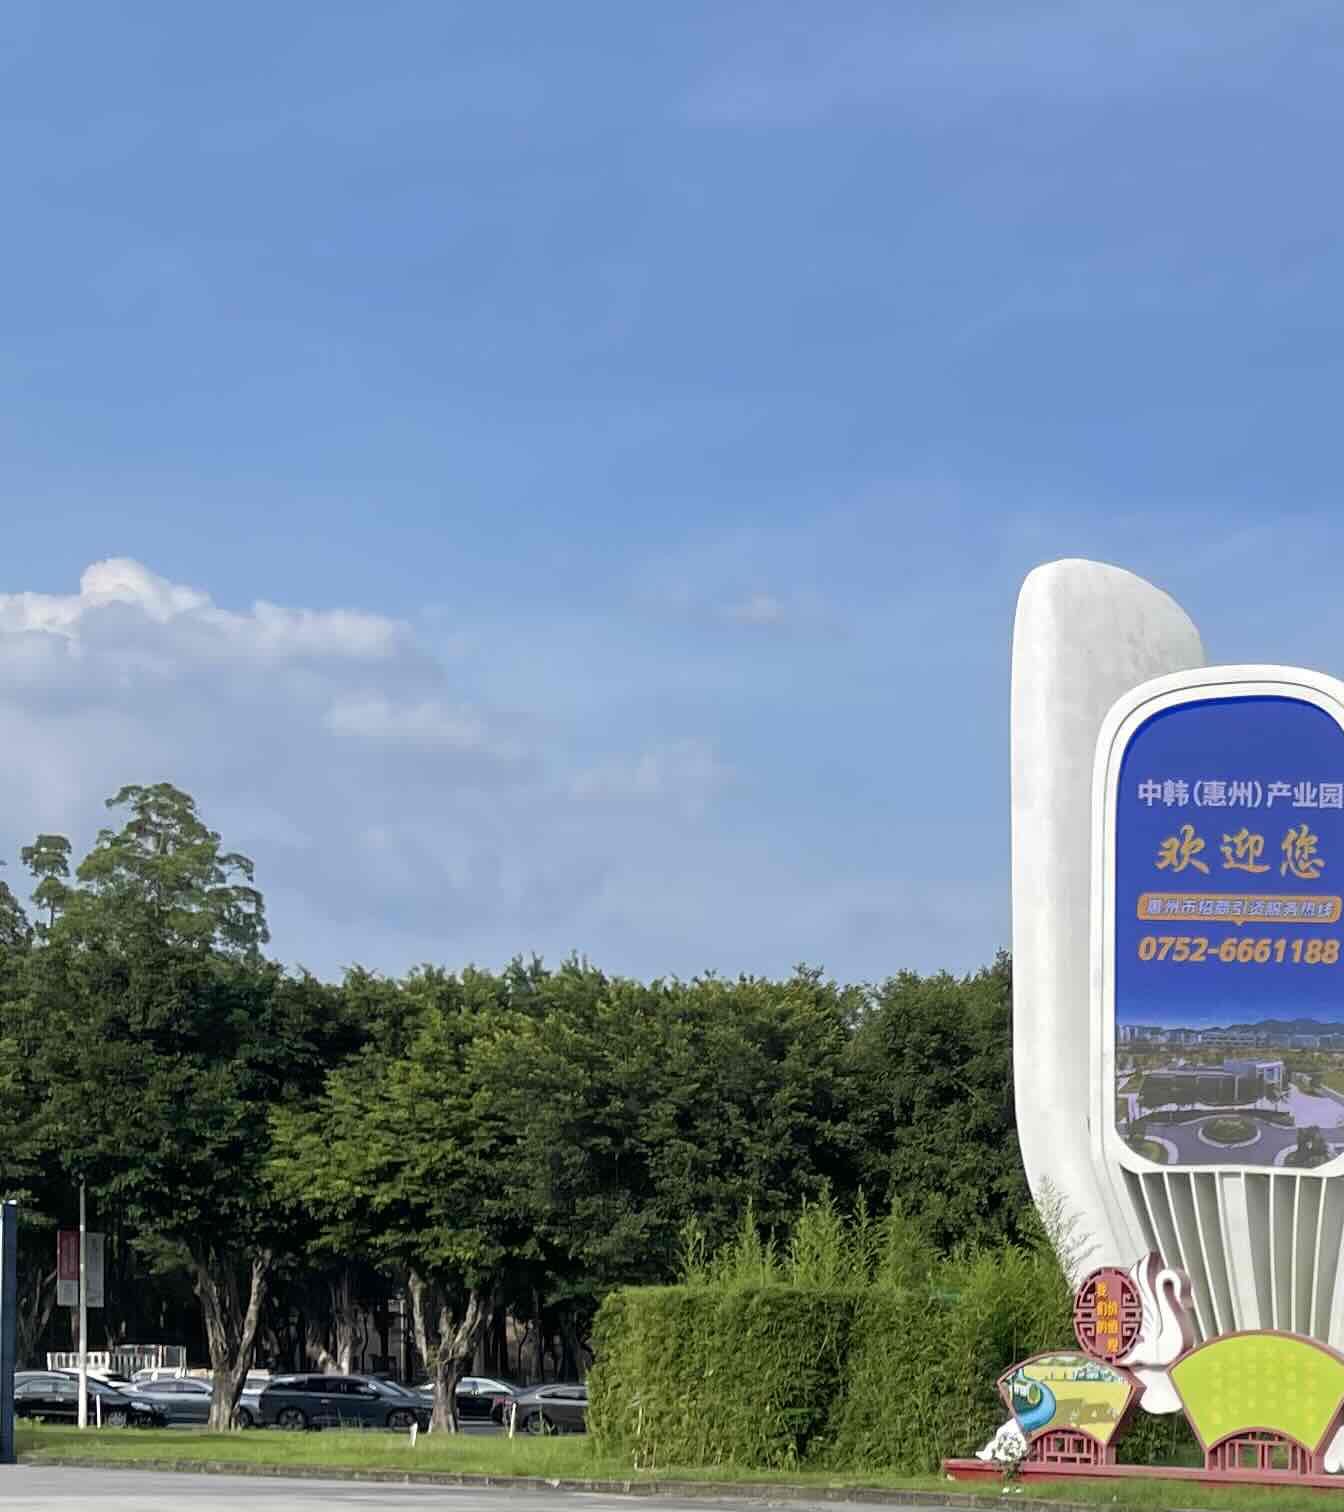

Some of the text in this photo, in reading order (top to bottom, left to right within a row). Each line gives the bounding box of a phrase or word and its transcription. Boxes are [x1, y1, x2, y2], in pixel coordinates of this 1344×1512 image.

[1138, 779, 1344, 808] 中韩(惠州)产业园
[1155, 824, 1325, 879] 欢迎您
[1138, 936, 1340, 963] 0752-6661188
